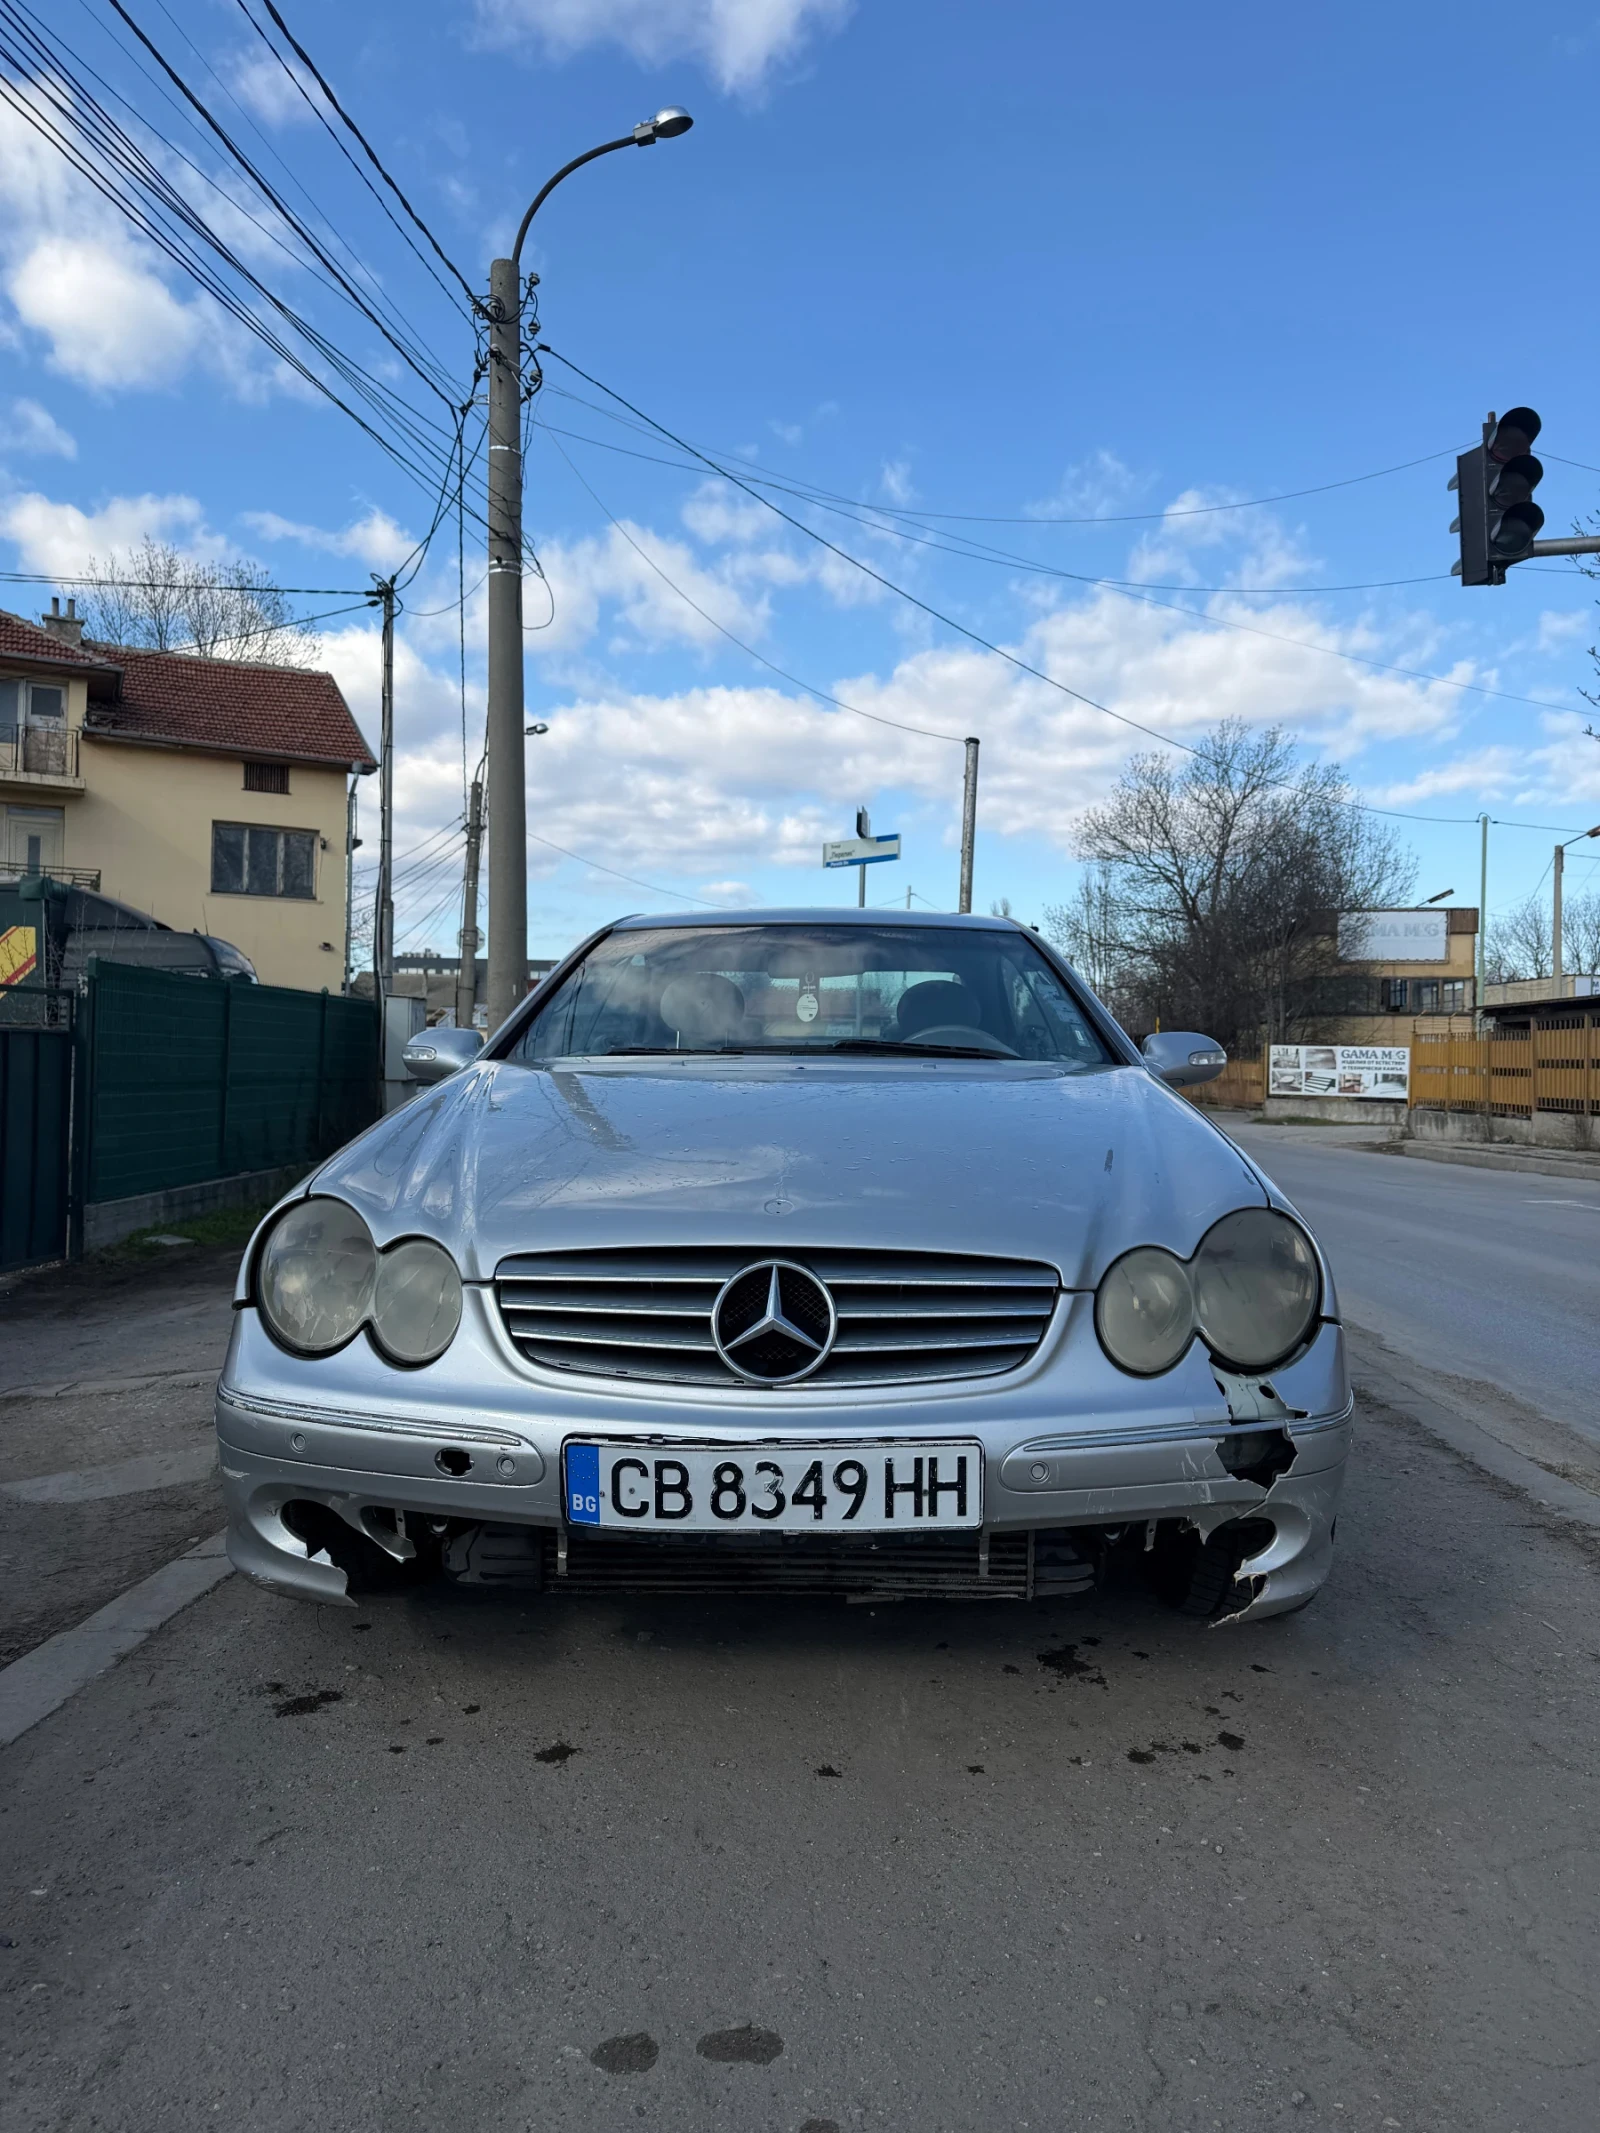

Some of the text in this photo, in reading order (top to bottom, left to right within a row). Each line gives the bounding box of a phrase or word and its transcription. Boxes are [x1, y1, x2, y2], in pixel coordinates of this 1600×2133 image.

[1341, 1049, 1378, 1059] GAMA
[611, 1456, 968, 1520] CB 8349 HH
[572, 1493, 597, 1514] BG
